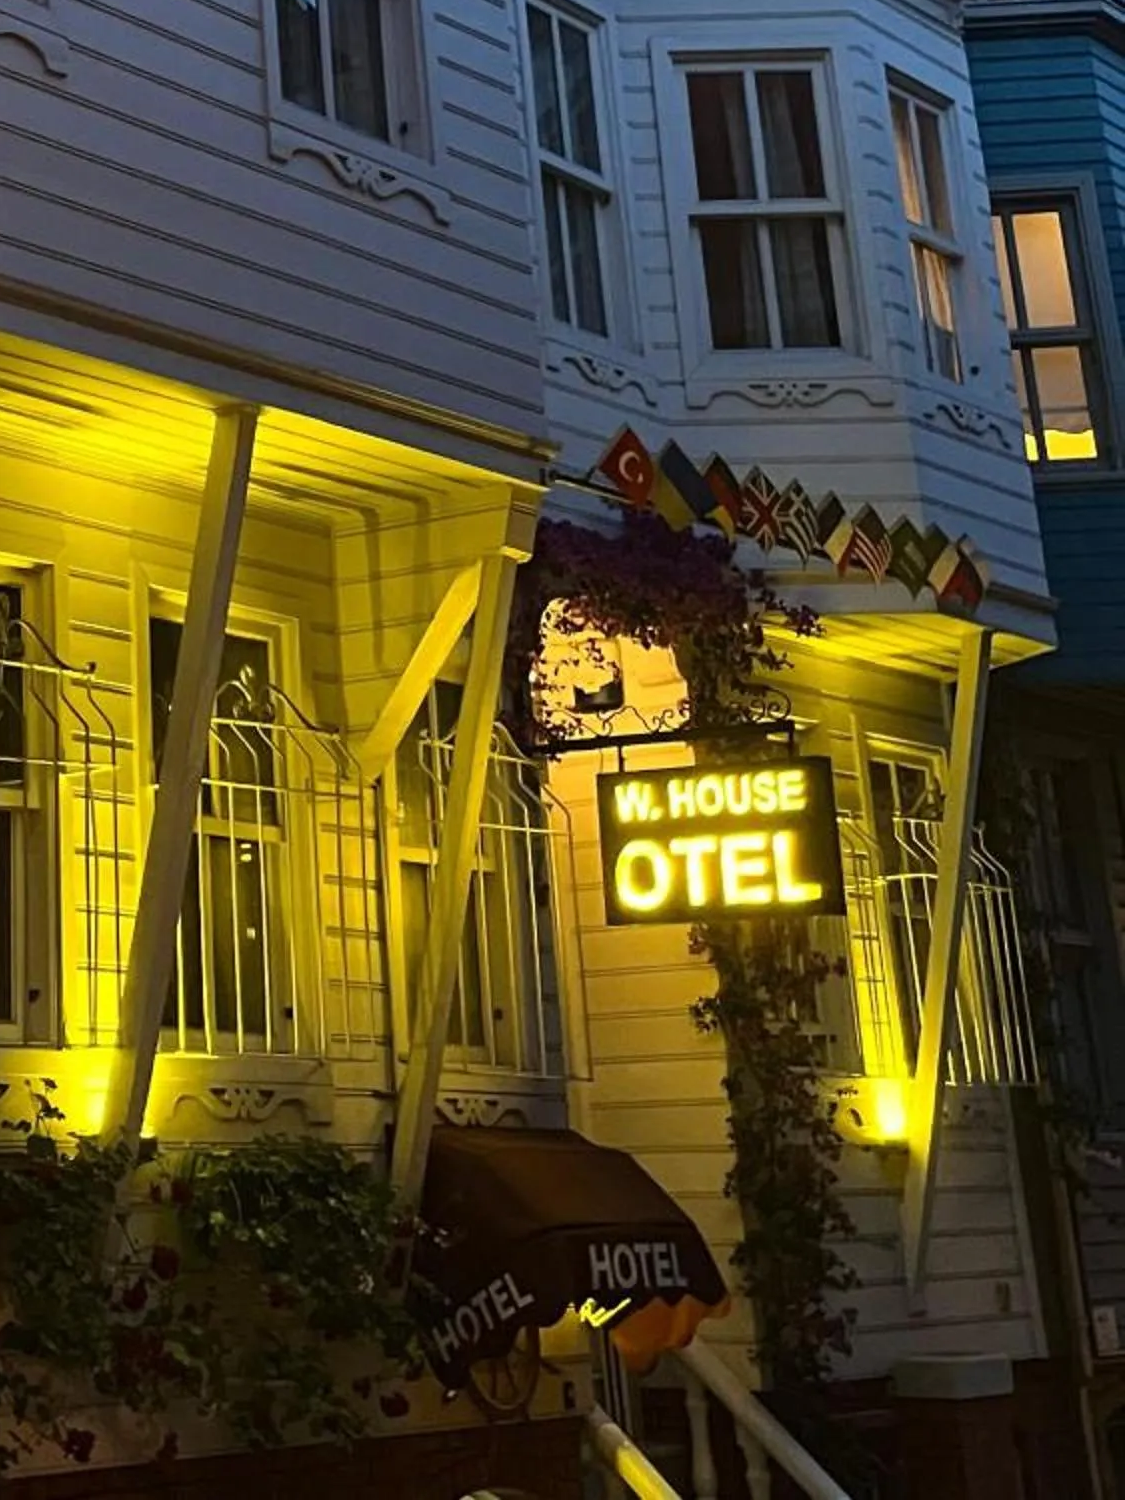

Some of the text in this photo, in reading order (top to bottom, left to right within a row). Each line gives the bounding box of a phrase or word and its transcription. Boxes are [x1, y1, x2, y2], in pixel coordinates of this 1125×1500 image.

[614, 770, 806, 822] W. HOUSE
[615, 831, 822, 912] OTEL
[589, 1243, 688, 1290] HOTEL
[432, 1273, 535, 1363] HOTEL
